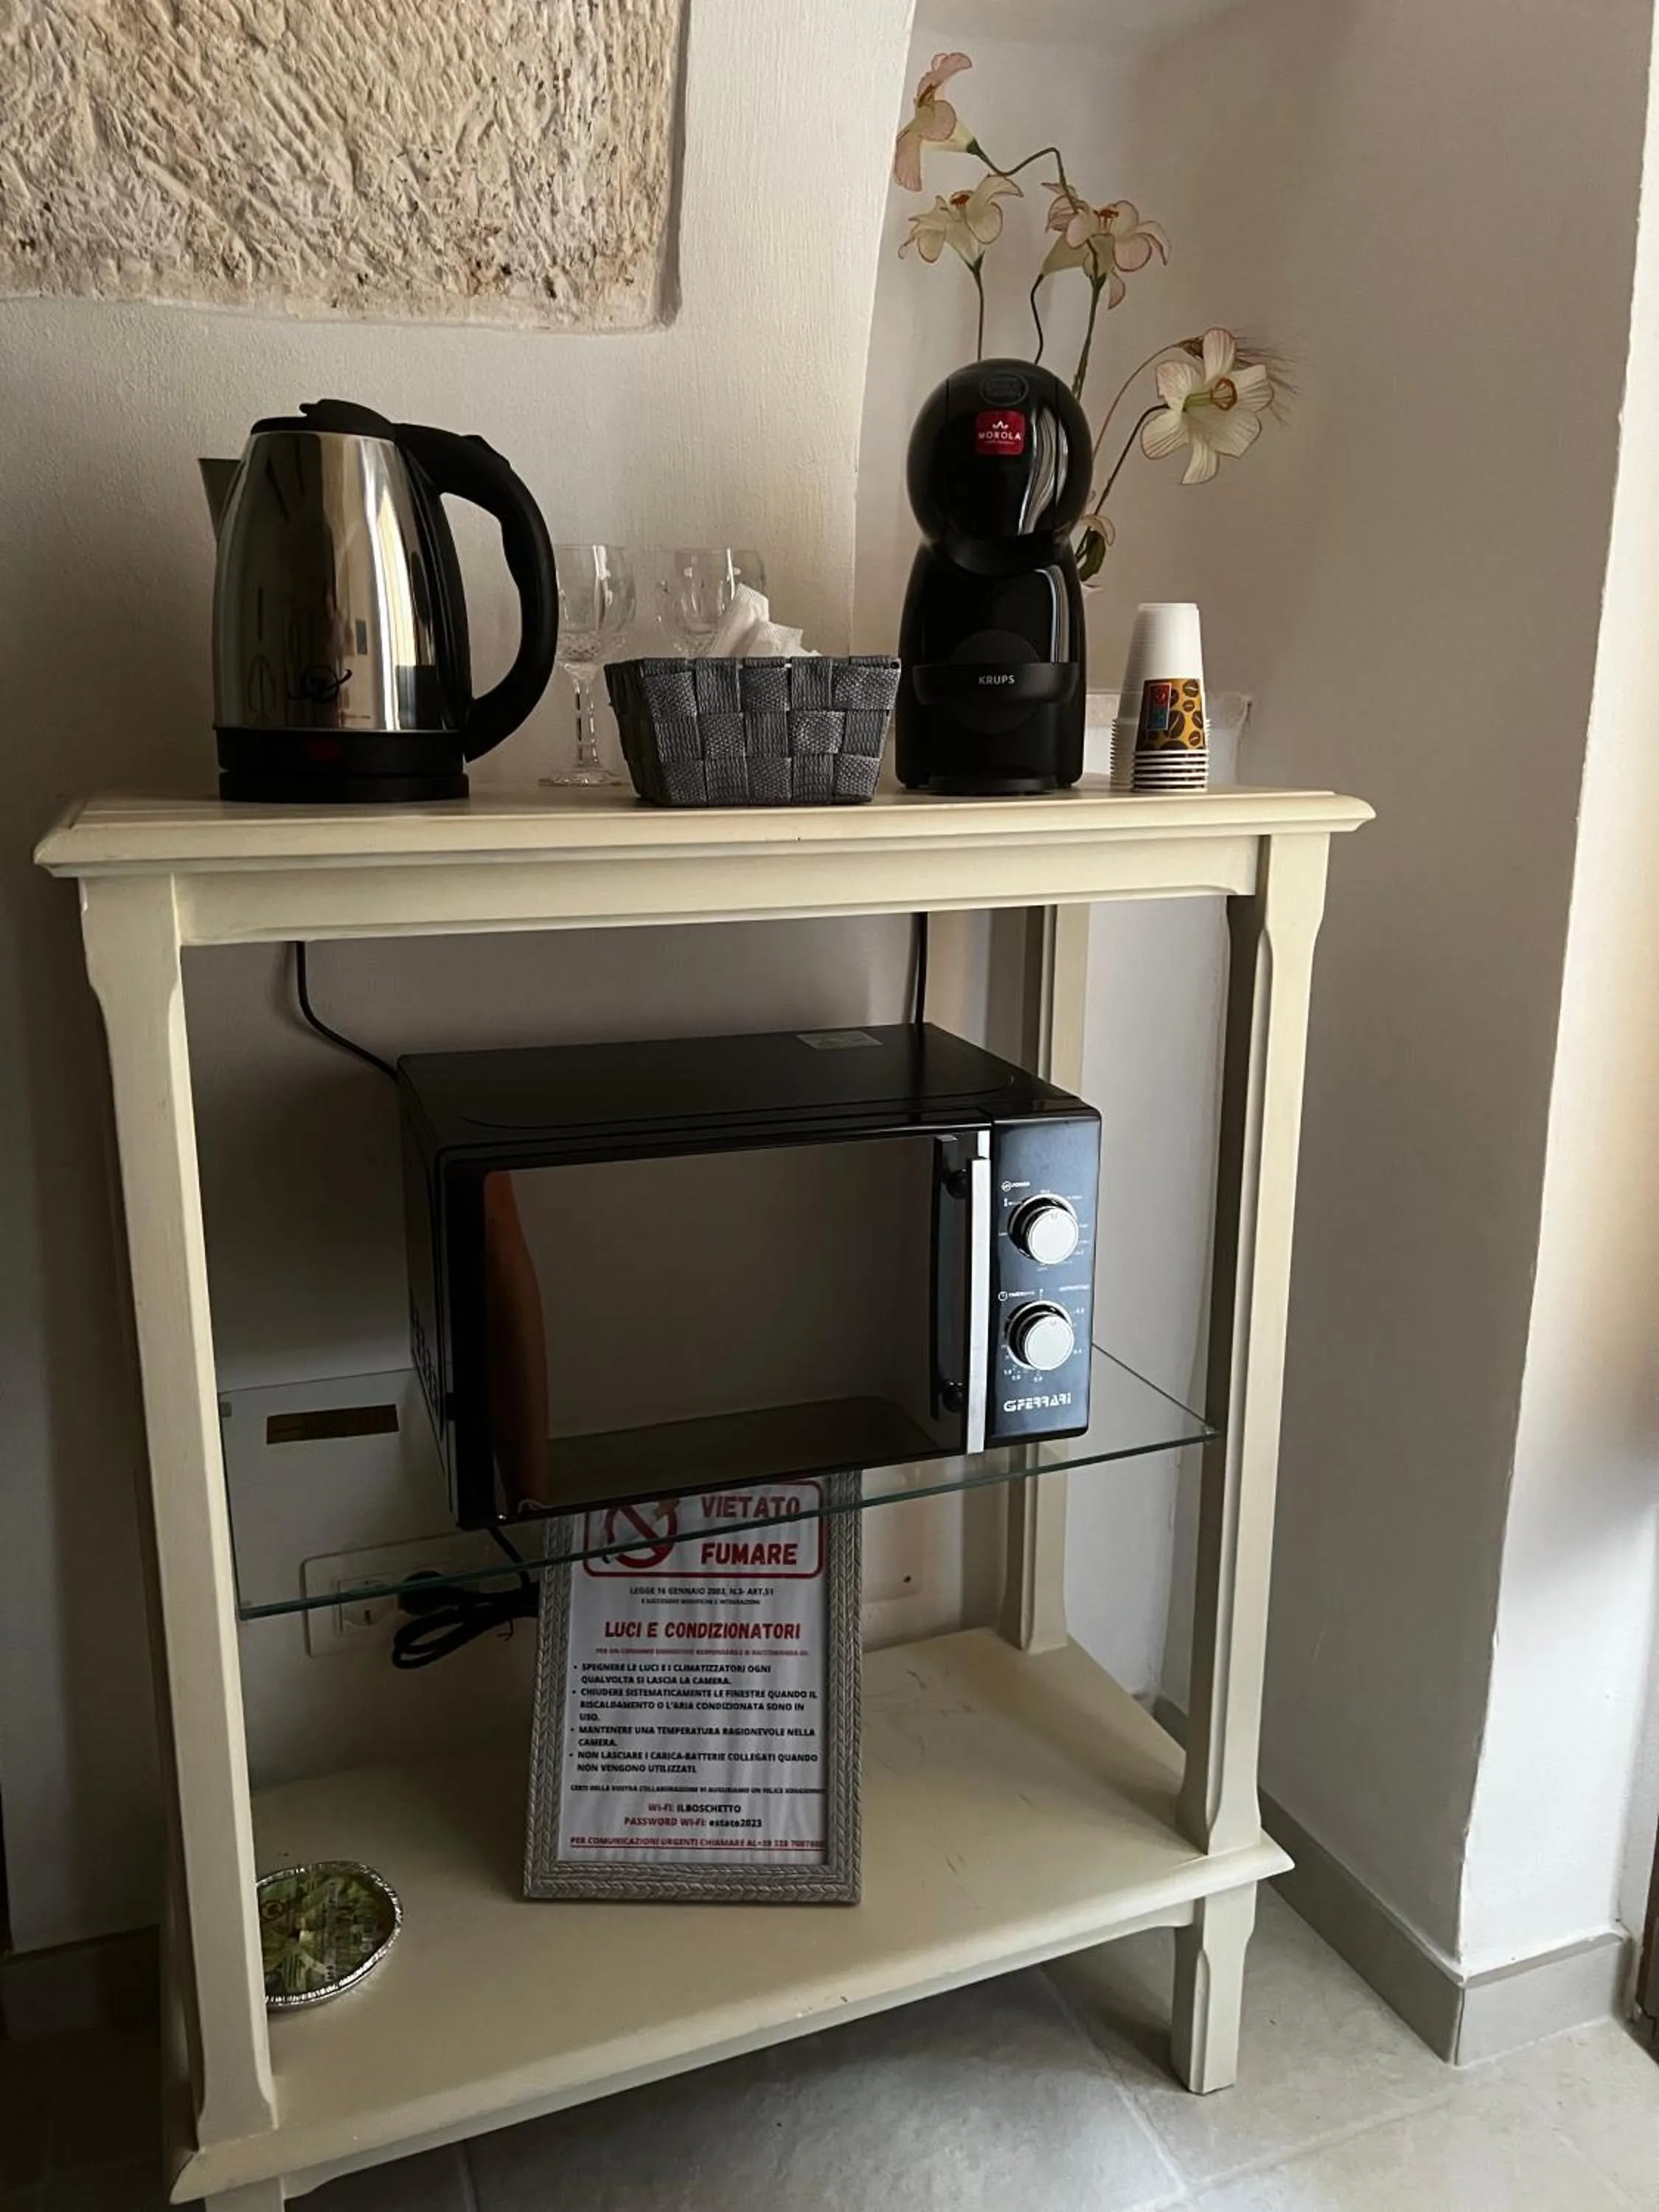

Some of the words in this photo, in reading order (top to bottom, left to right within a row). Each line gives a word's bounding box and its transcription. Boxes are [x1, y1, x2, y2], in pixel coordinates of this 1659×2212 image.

[978, 675, 1015, 685] KRUPS
[702, 1495, 801, 1517] VIETATO
[701, 1543, 799, 1565] FUMARE
[630, 1587, 655, 1595] LEGGE
[668, 1587, 705, 1595] GENNAIO
[605, 1621, 641, 1638] LUCI
[647, 1622, 658, 1638] E
[664, 1622, 801, 1639] CONDIZIONATORI
[582, 1663, 625, 1672] SPEGNERE
[627, 1663, 637, 1672] LE
[639, 1663, 659, 1672] LUCI
[673, 1663, 745, 1672] CLIMATIZZATORI
[748, 1664, 771, 1673] OGNI
[581, 1675, 634, 1684] QUALVOLTA
[647, 1676, 678, 1684] LASCIA
[679, 1676, 690, 1684] LA
[692, 1677, 731, 1685] CAMERA.
[580, 1688, 623, 1697] CHIUDERE
[625, 1688, 712, 1697] SISTEMATICAMENTE
[714, 1689, 723, 1697] LE
[725, 1689, 765, 1698] FINESTRE
[768, 1691, 807, 1700] QUANDO
[580, 1700, 655, 1709] RISCALDAMENTO
[657, 1701, 664, 1709] O
[666, 1702, 694, 1710] L'ARIA
[695, 1703, 765, 1711] CONDIZIONATA
[766, 1703, 792, 1711] SONO
[794, 1703, 804, 1711] IN
[578, 1726, 633, 1734] MANTENERE
[635, 1726, 655, 1734] UNA
[657, 1726, 720, 1735] TEMPERATURA
[722, 1728, 785, 1736] RAGIONEVOLE
[787, 1728, 815, 1736] NELLA
[577, 1751, 599, 1759] NON
[601, 1751, 642, 1760] LASCIARE
[650, 1752, 726, 1761] CARICA-BATTERIE
[727, 1753, 776, 1761] COLLEGATI
[778, 1753, 818, 1763] QUANDO
[577, 1763, 598, 1772] NON
[600, 1764, 646, 1773] VENGONO
[676, 1804, 741, 1813] ILBOSCHETTO
[625, 1817, 678, 1826] PASSWORD
[709, 1818, 762, 1828] estate2023
[588, 1837, 659, 1846] COMUNICAZIONI
[661, 1837, 698, 1846] URGENTI
[700, 1838, 745, 1847] CHIAMARE
